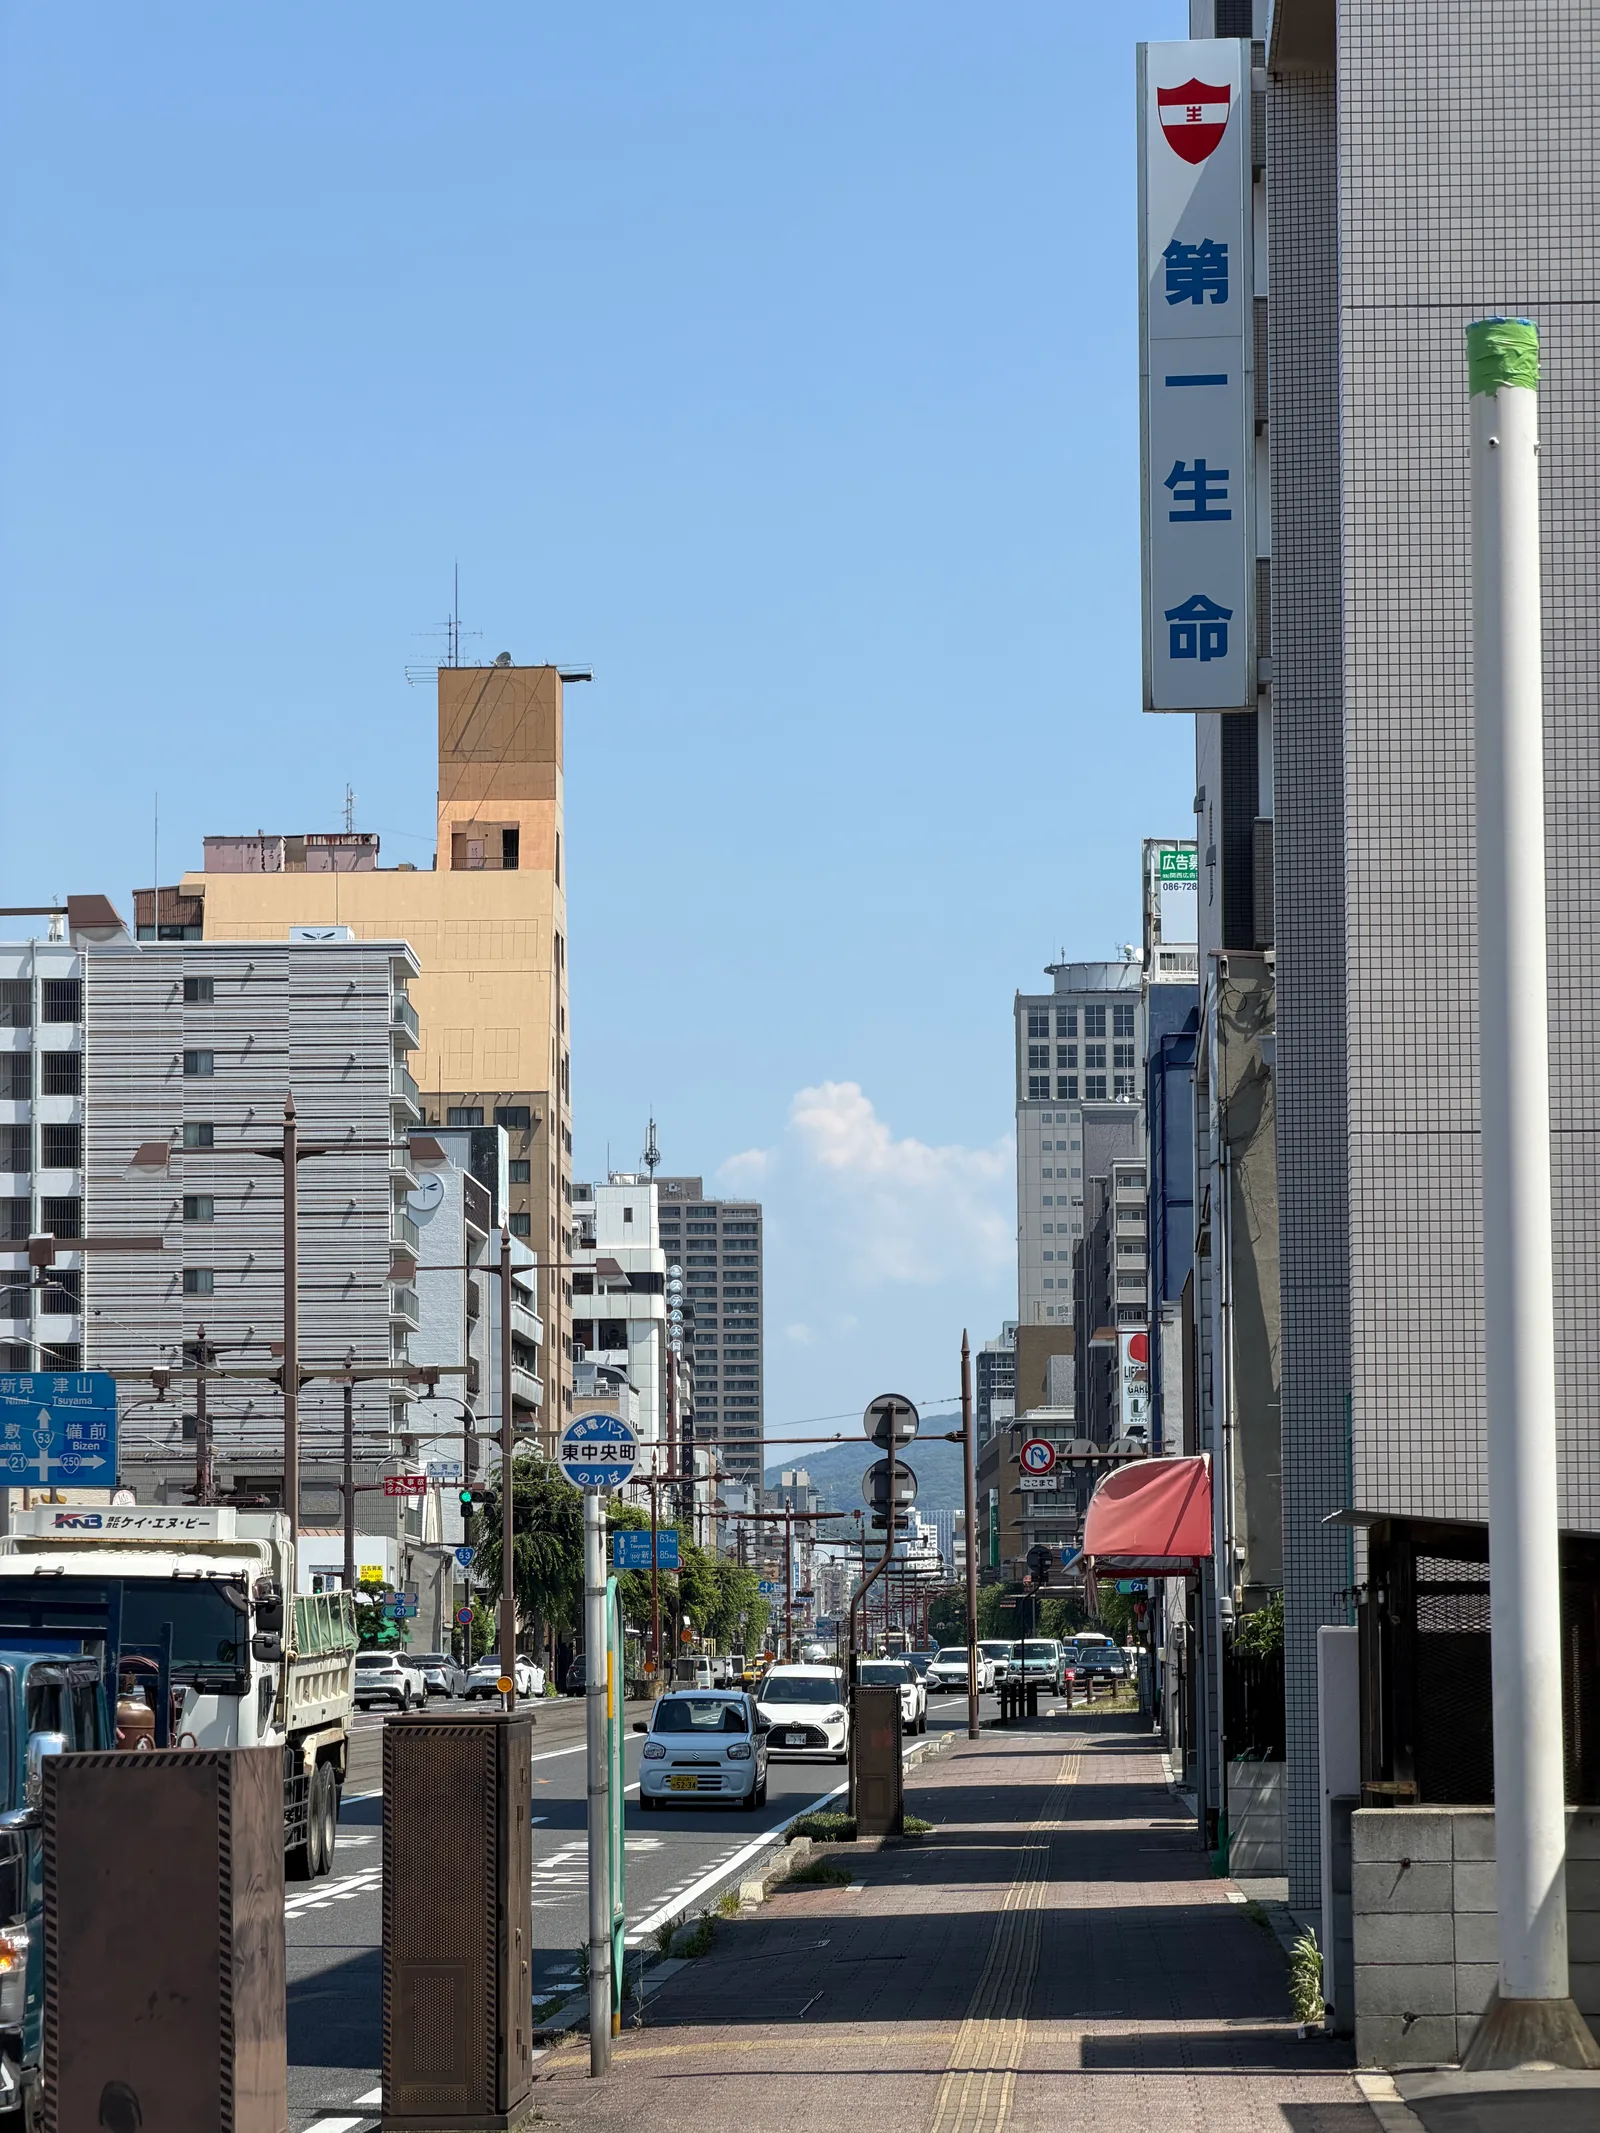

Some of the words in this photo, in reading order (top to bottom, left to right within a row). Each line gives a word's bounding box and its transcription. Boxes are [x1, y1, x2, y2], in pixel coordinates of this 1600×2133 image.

[1164, 238, 1234, 663] 第一生命
[1163, 854, 1197, 870] 広告募
[0, 1378, 34, 1394] 新見
[53, 1377, 92, 1393] 津山
[52, 1396, 93, 1407] Tsuyama
[66, 1423, 107, 1440] 備前
[573, 1418, 625, 1439] 岡電バス
[38, 1433, 51, 1444] 53
[72, 1441, 100, 1451] Bizen
[561, 1443, 637, 1461] 東中央町
[11, 1456, 24, 1468] 21
[63, 1457, 80, 1467] 250
[577, 1470, 621, 1485] のりば
[458, 1551, 471, 1560] 53
[1133, 1583, 1143, 1592] 21
[396, 1607, 405, 1615] 21
